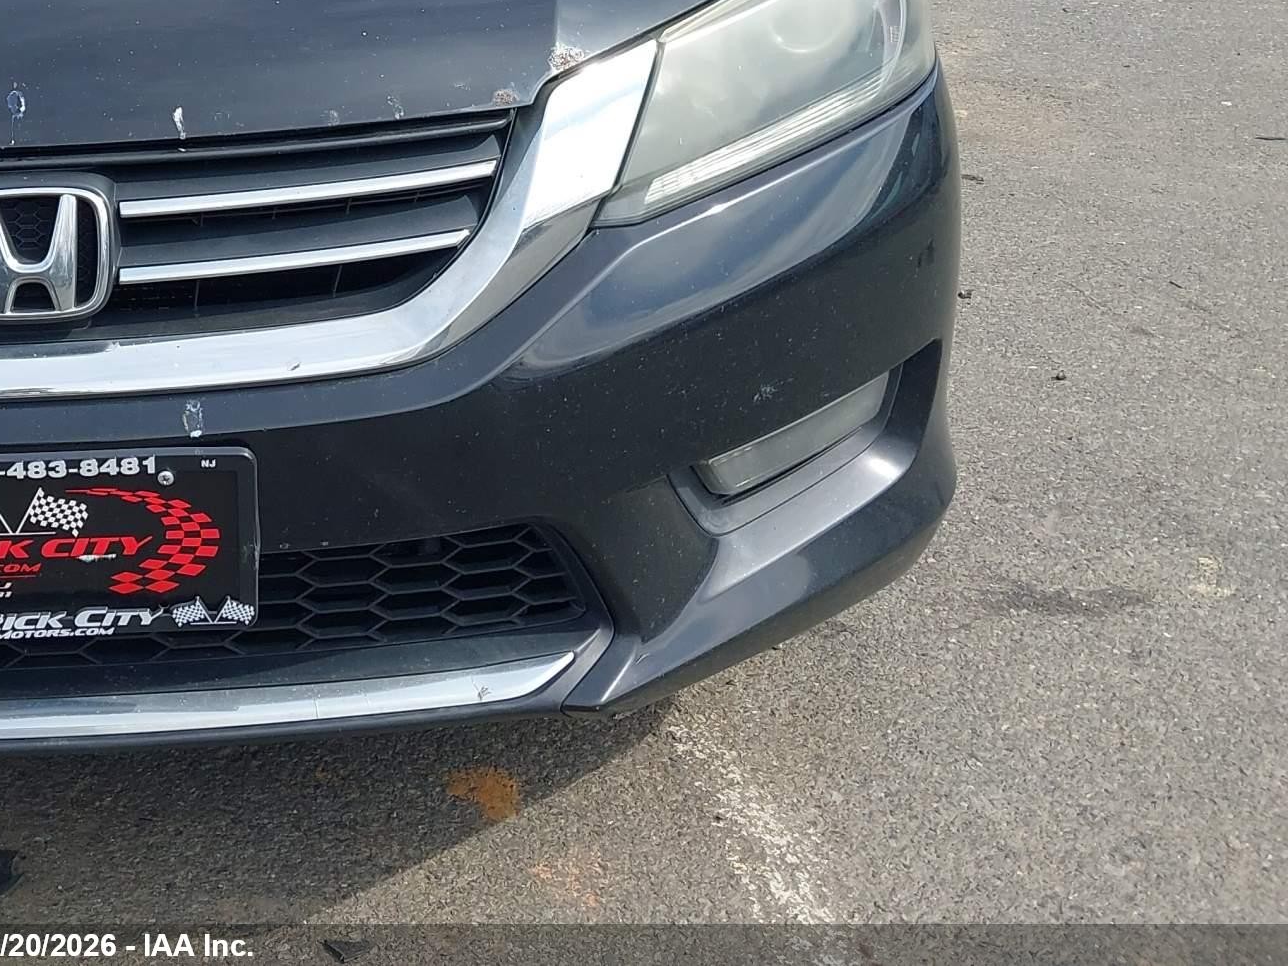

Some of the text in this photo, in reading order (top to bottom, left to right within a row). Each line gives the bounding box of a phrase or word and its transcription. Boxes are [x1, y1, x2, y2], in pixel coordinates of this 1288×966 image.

[201, 459, 217, 469] NJ
[41, 536, 153, 558] CITY
[75, 607, 164, 629] CITY
